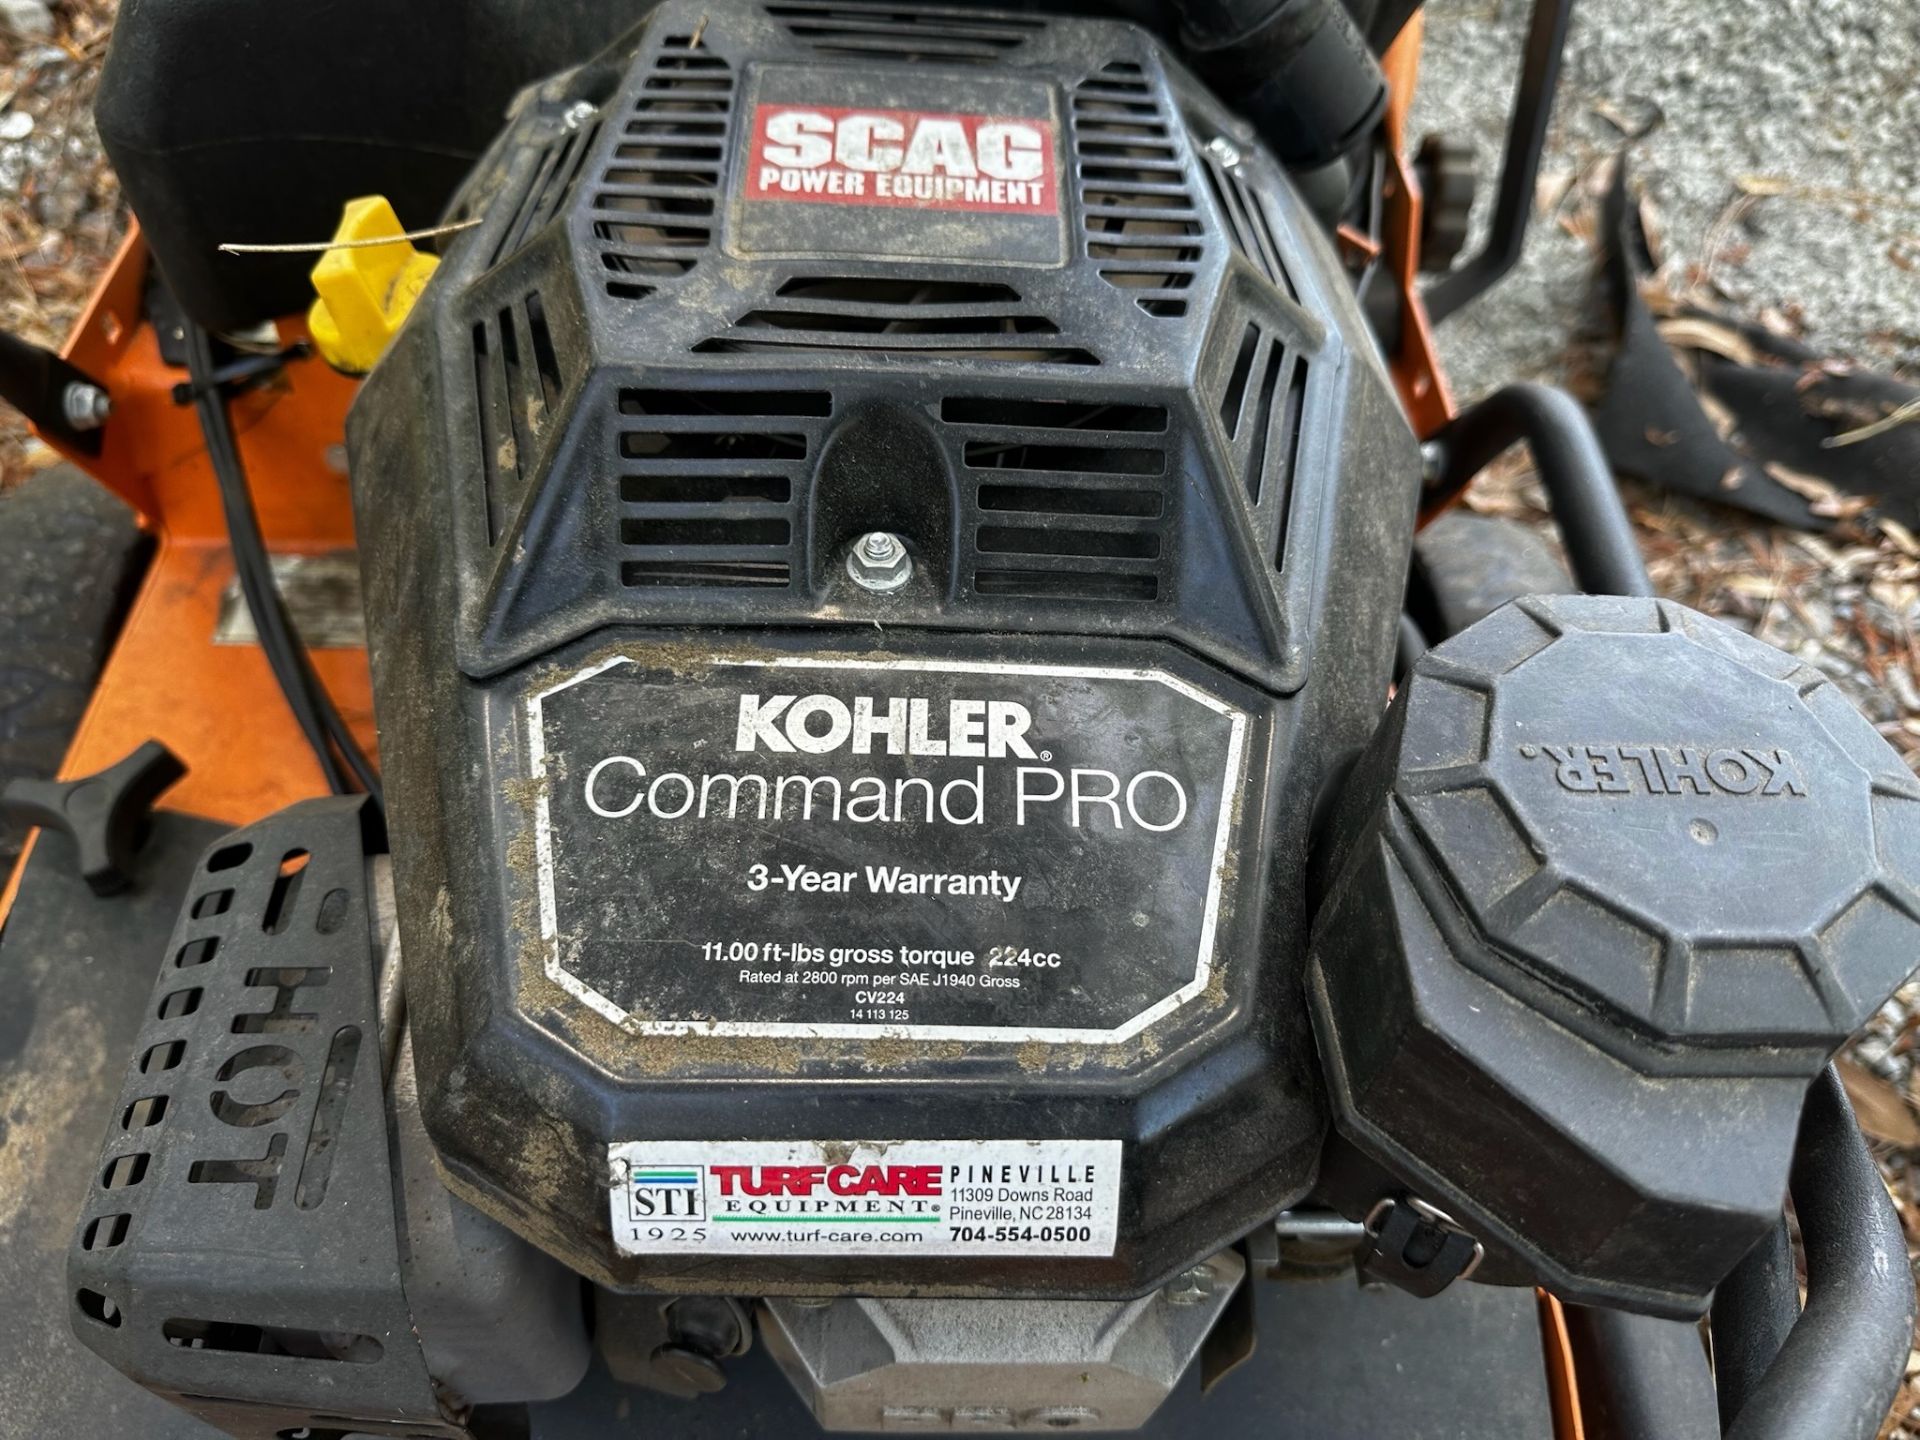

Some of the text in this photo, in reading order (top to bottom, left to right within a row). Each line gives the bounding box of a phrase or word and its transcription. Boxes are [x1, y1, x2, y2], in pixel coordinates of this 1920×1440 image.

[762, 111, 1044, 181] SCAG
[759, 167, 1045, 206] POWER EQUIPMENT
[735, 694, 1039, 760] KOHLER
[1541, 746, 1806, 797] KOHLER
[584, 756, 1188, 832] Command PRO
[746, 864, 1022, 902] 3-Year Warranty
[701, 941, 1062, 969] 11.00 ft-lbs gross torque 224cc
[739, 969, 1021, 989] Rated at 2800 rpm per SAE J1940 Gross
[855, 990, 905, 1005] CV224
[850, 1009, 910, 1021] 14 113 125
[186, 965, 334, 1211] HOT
[950, 1165, 1096, 1184] PINEVILLE
[634, 1187, 699, 1218] STI
[951, 1188, 1094, 1203] 11309 Downs Road
[726, 1200, 929, 1215] EQUIPMENT
[949, 1206, 1093, 1223] Pineville, NC 28134
[630, 1227, 708, 1242] 1925
[730, 1228, 924, 1243] www.turf-care.com
[950, 1226, 1091, 1243] 704-554-0500
